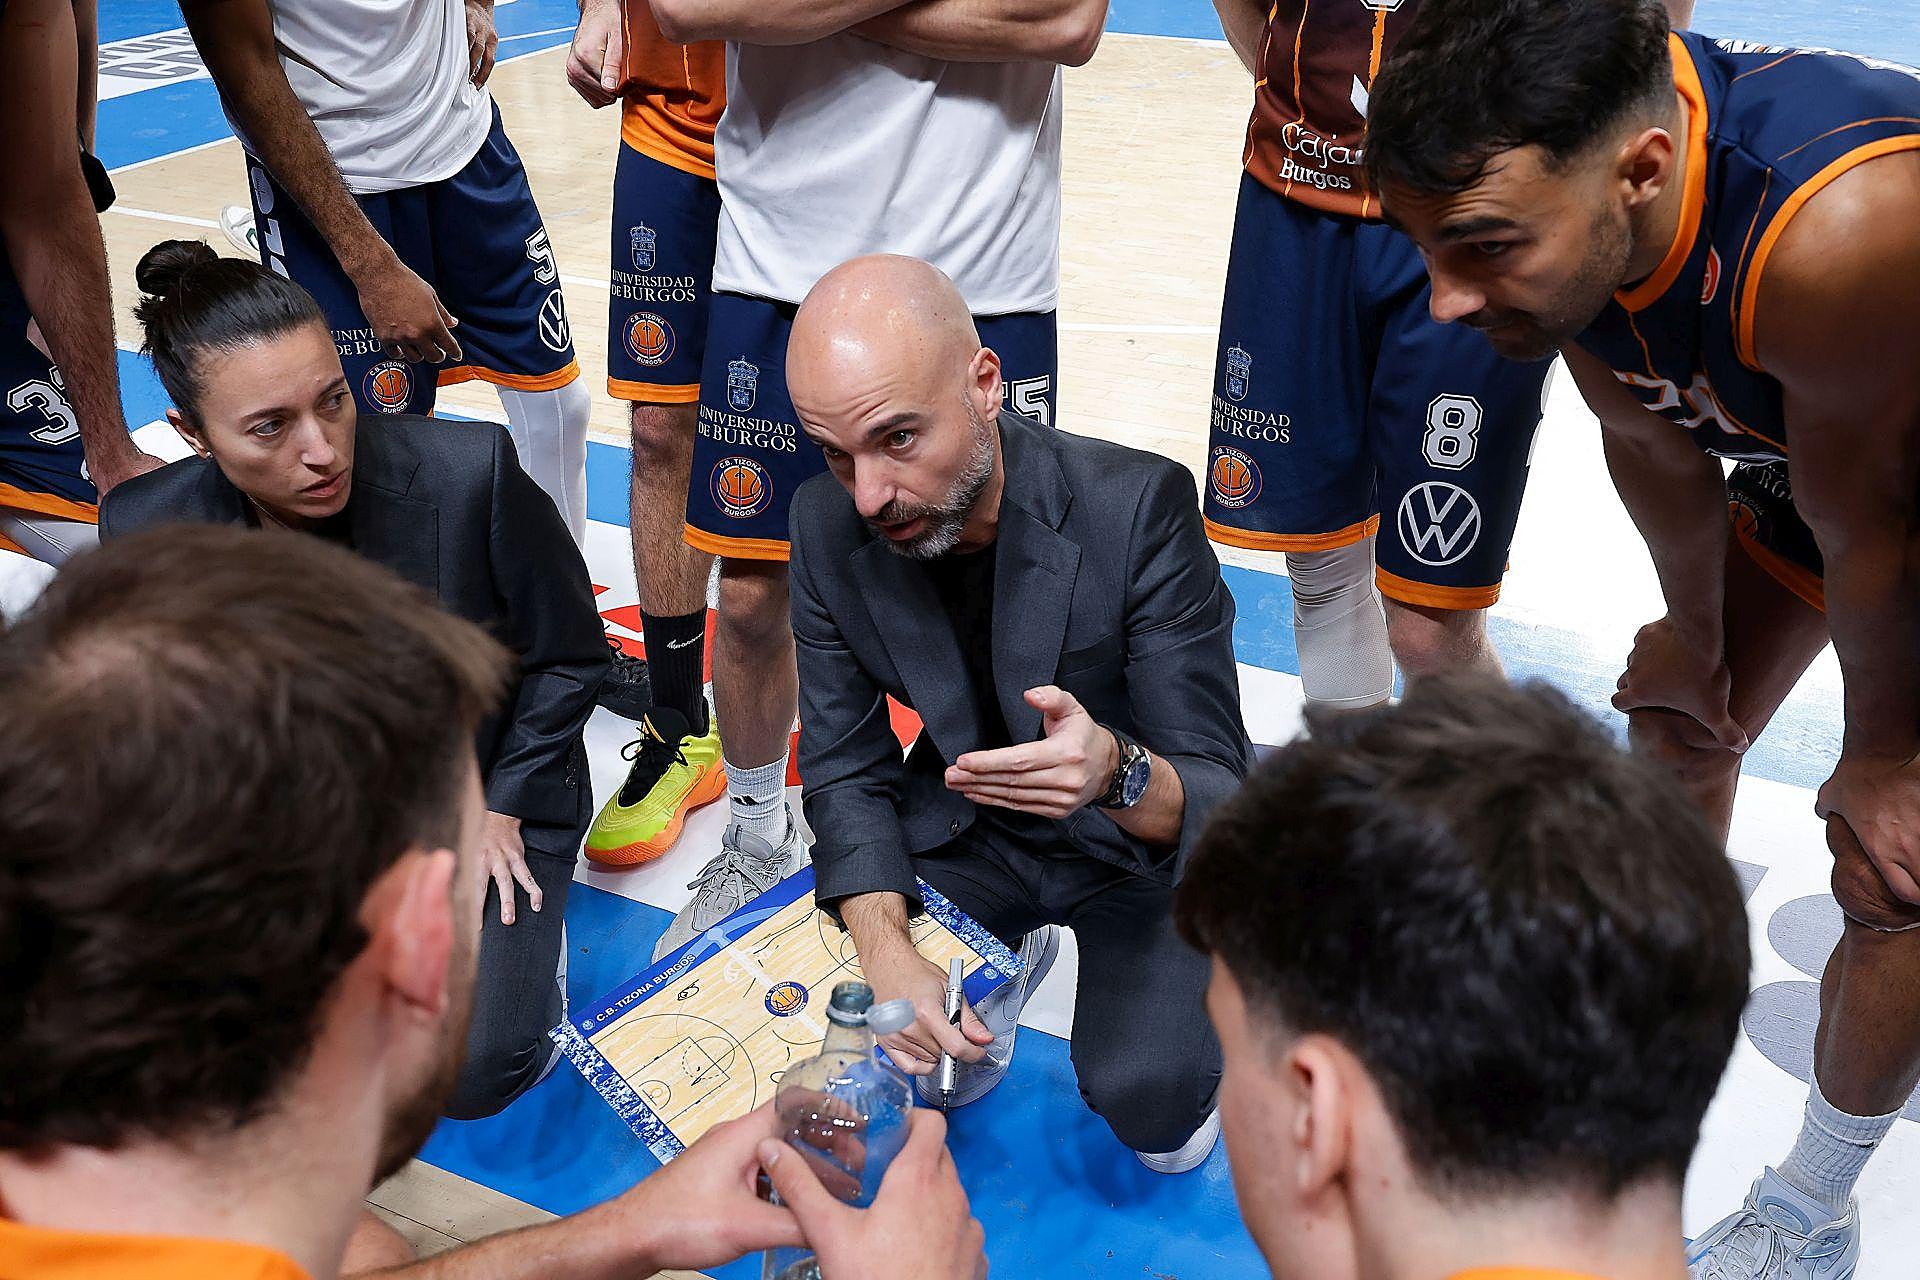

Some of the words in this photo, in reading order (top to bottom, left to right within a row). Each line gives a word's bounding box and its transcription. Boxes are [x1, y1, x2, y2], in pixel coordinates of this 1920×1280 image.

[1279, 156, 1352, 190] Burgos
[524, 226, 558, 286] 5
[612, 269, 695, 288] UNIVERSIDAD
[611, 284, 622, 297] DE
[623, 284, 696, 302] BURGOS
[641, 313, 665, 327] TIZONA
[354, 339, 382, 355] BU
[383, 361, 406, 371] TIZONA
[636, 355, 663, 366] BURGOS
[699, 403, 796, 438] UNIVERSIDAD
[1213, 409, 1291, 444] BURGOS
[698, 420, 711, 438] DE
[712, 423, 797, 453] BURGOS
[1421, 392, 1484, 472] 8
[719, 460, 733, 470] C.B.
[733, 458, 762, 474] TIZONA
[1225, 447, 1252, 466] TIZONA
[1215, 493, 1245, 507] BURGOS
[723, 506, 757, 518] BURGOS
[596, 1007, 618, 1022] C.B.
[614, 982, 655, 1010] TIZONA
[652, 953, 696, 985] BURGOS
